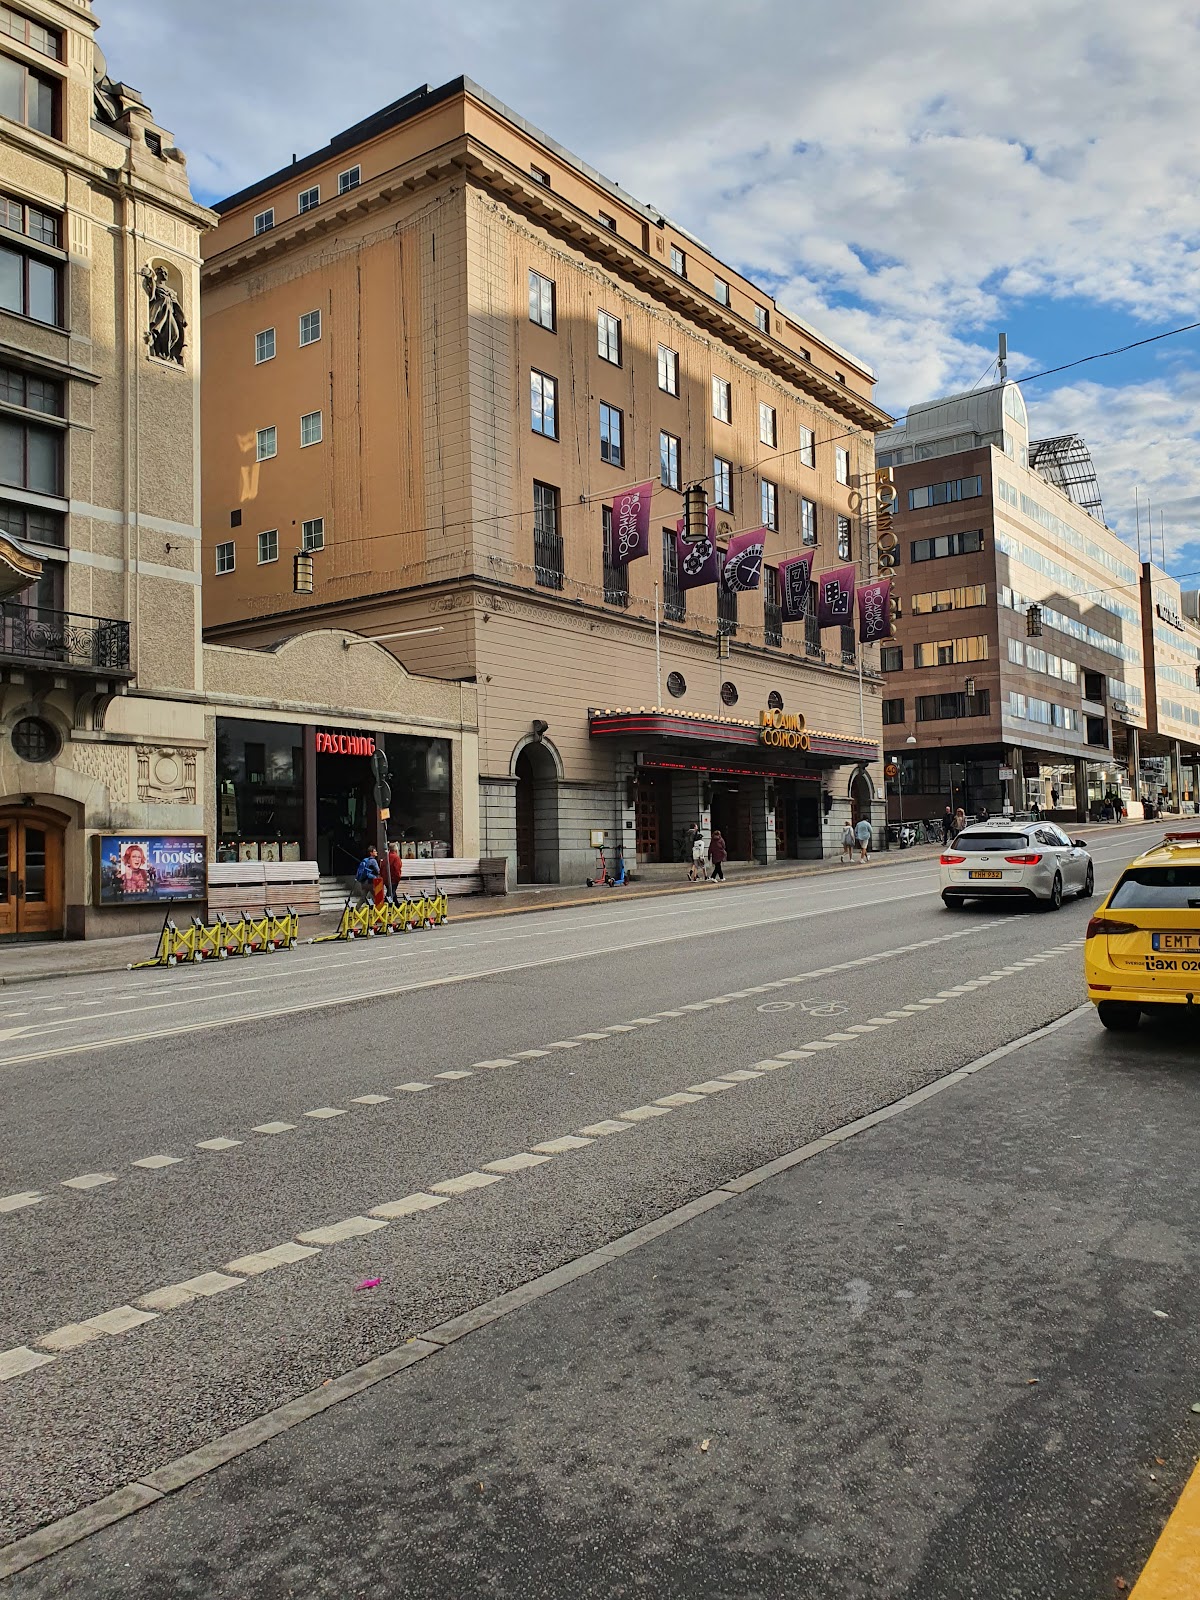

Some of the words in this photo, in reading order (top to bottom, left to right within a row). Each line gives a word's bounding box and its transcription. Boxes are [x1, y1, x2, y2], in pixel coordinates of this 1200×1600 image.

[619, 496, 631, 560] COSMOPOL
[628, 502, 640, 547] CASINO
[865, 590, 875, 638] COSMOPOL
[872, 595, 884, 631] CASINO
[771, 708, 806, 732] CASINO
[316, 732, 375, 756] FASCHING
[764, 730, 811, 750] COSMOPOL
[152, 848, 203, 864] Tootsie
[1165, 936, 1192, 947] EMT
[1182, 960, 1200, 970] 02
